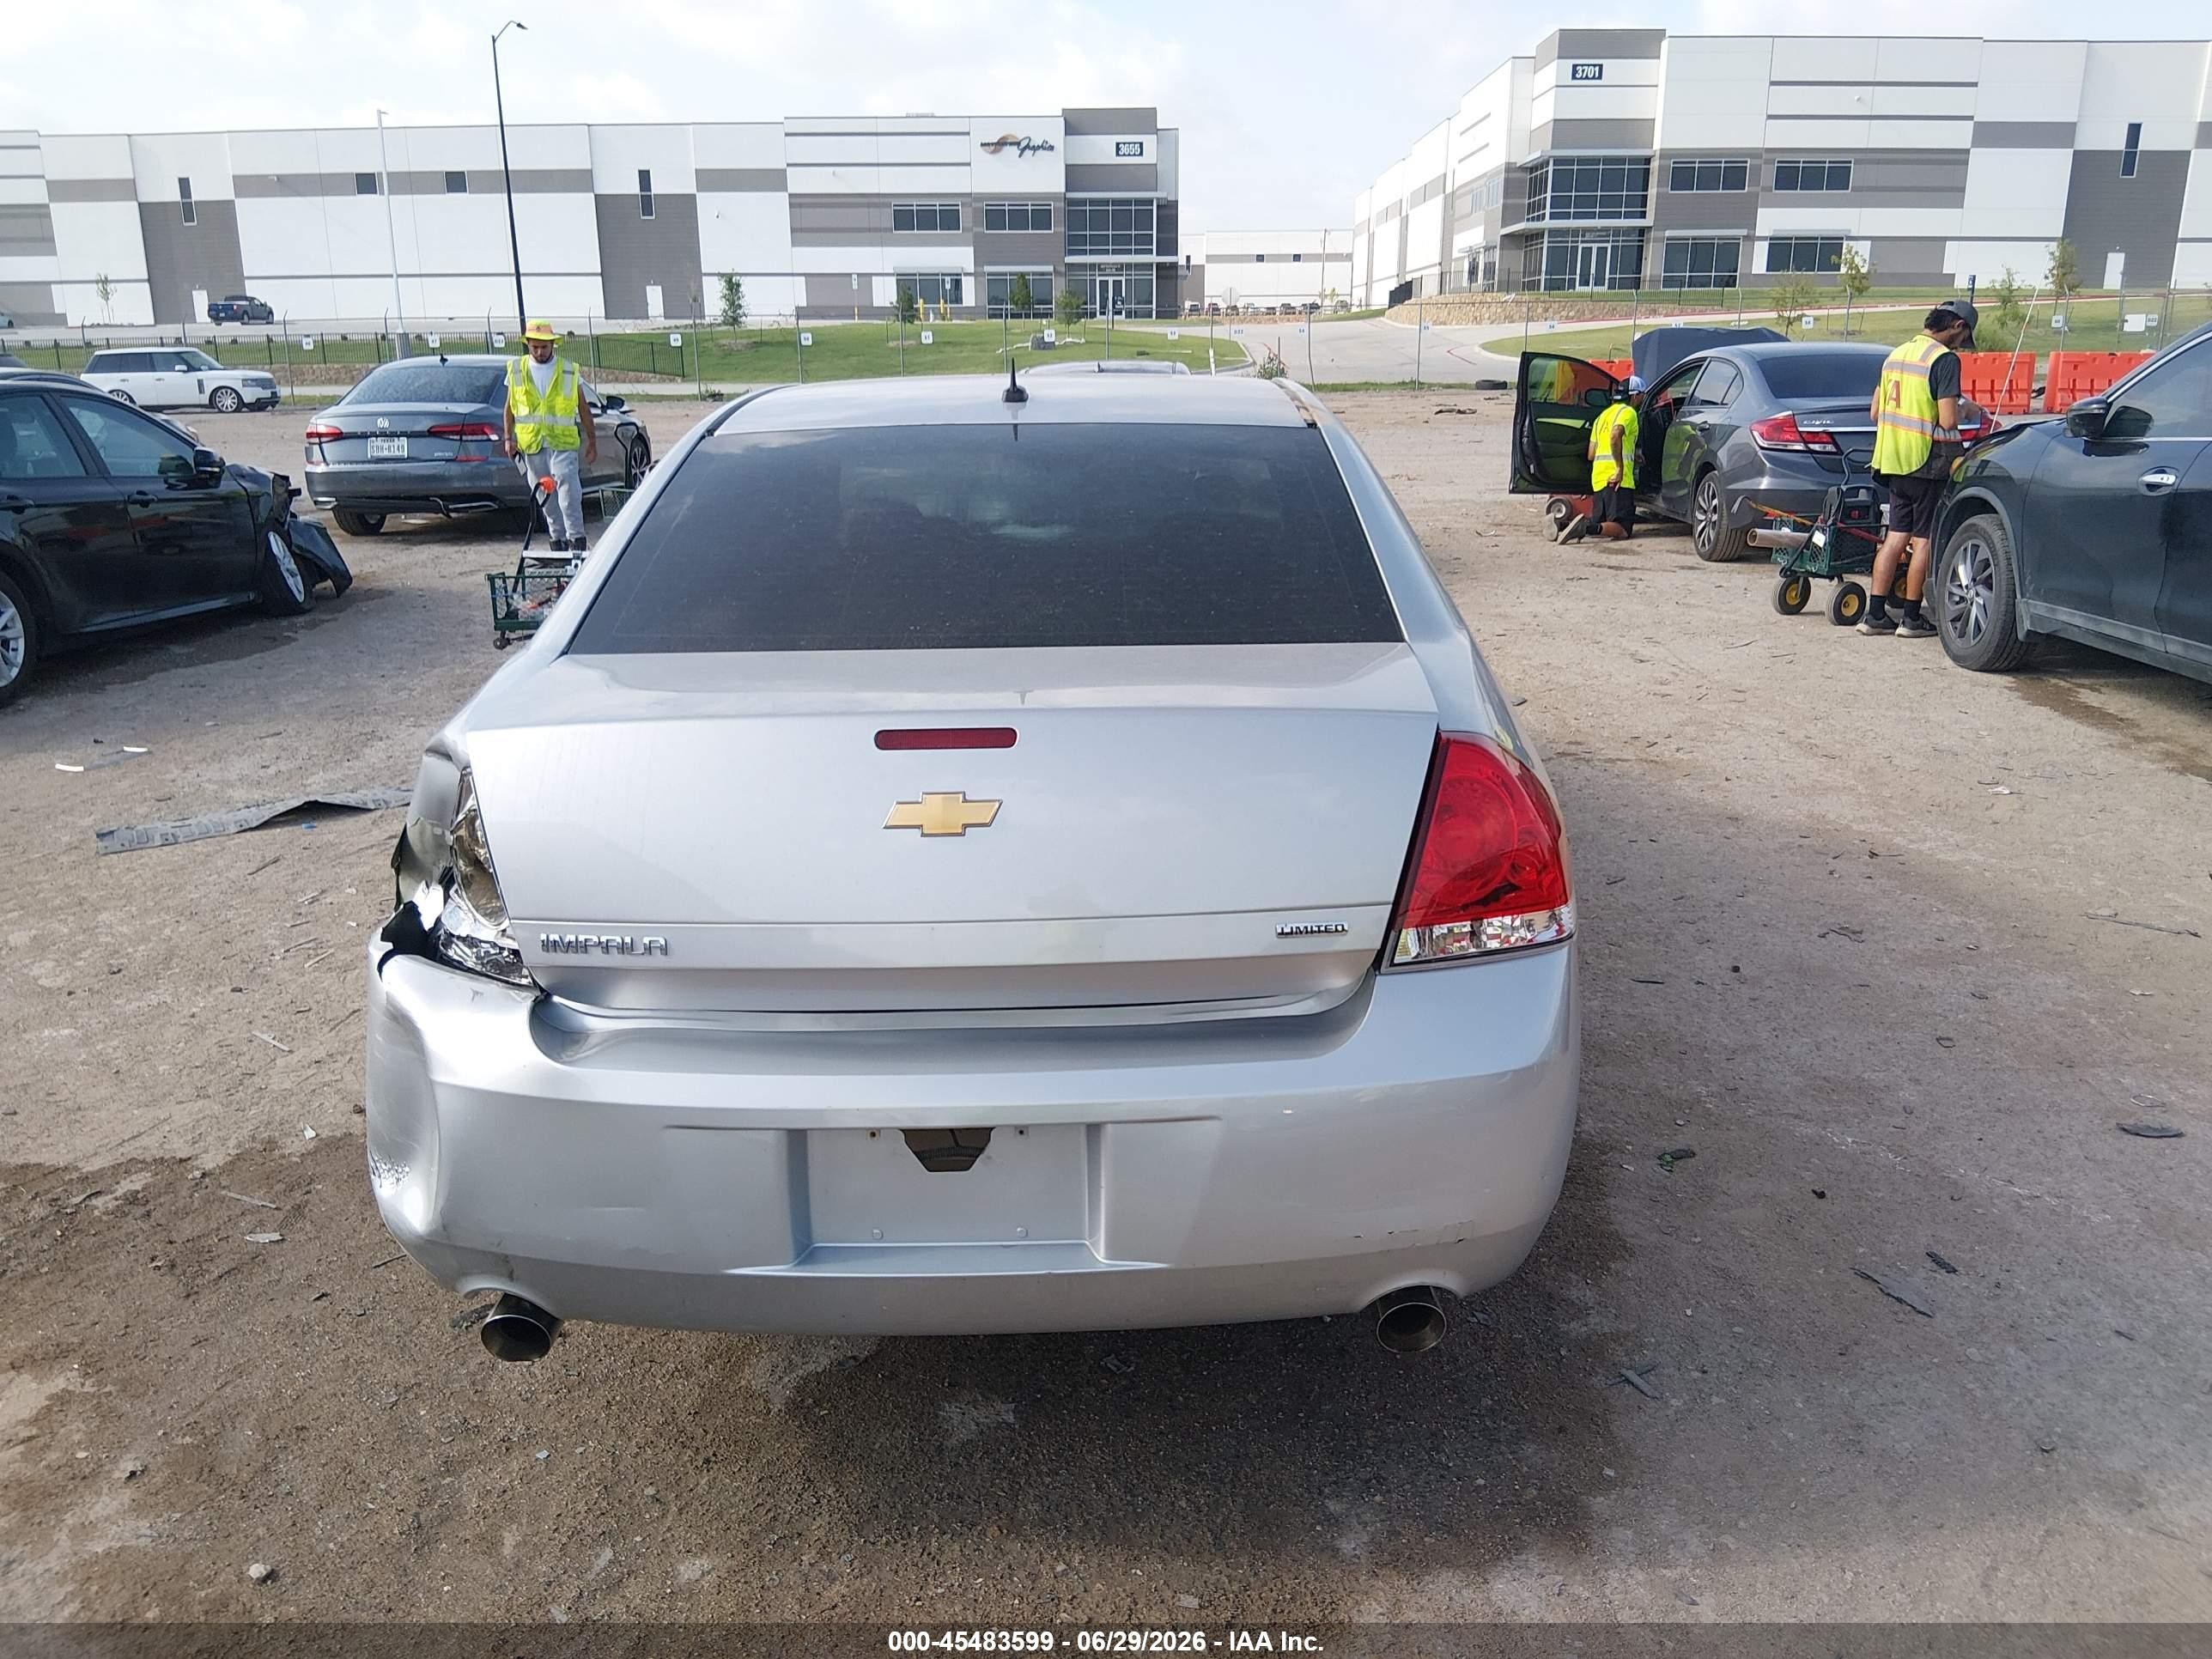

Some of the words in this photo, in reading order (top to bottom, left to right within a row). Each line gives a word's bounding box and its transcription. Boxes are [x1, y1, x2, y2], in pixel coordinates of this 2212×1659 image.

[1575, 65, 1600, 79] 3701
[1118, 143, 1140, 155] 3655
[1276, 921, 1348, 938] LIMITED
[540, 933, 668, 956] IMPALA
